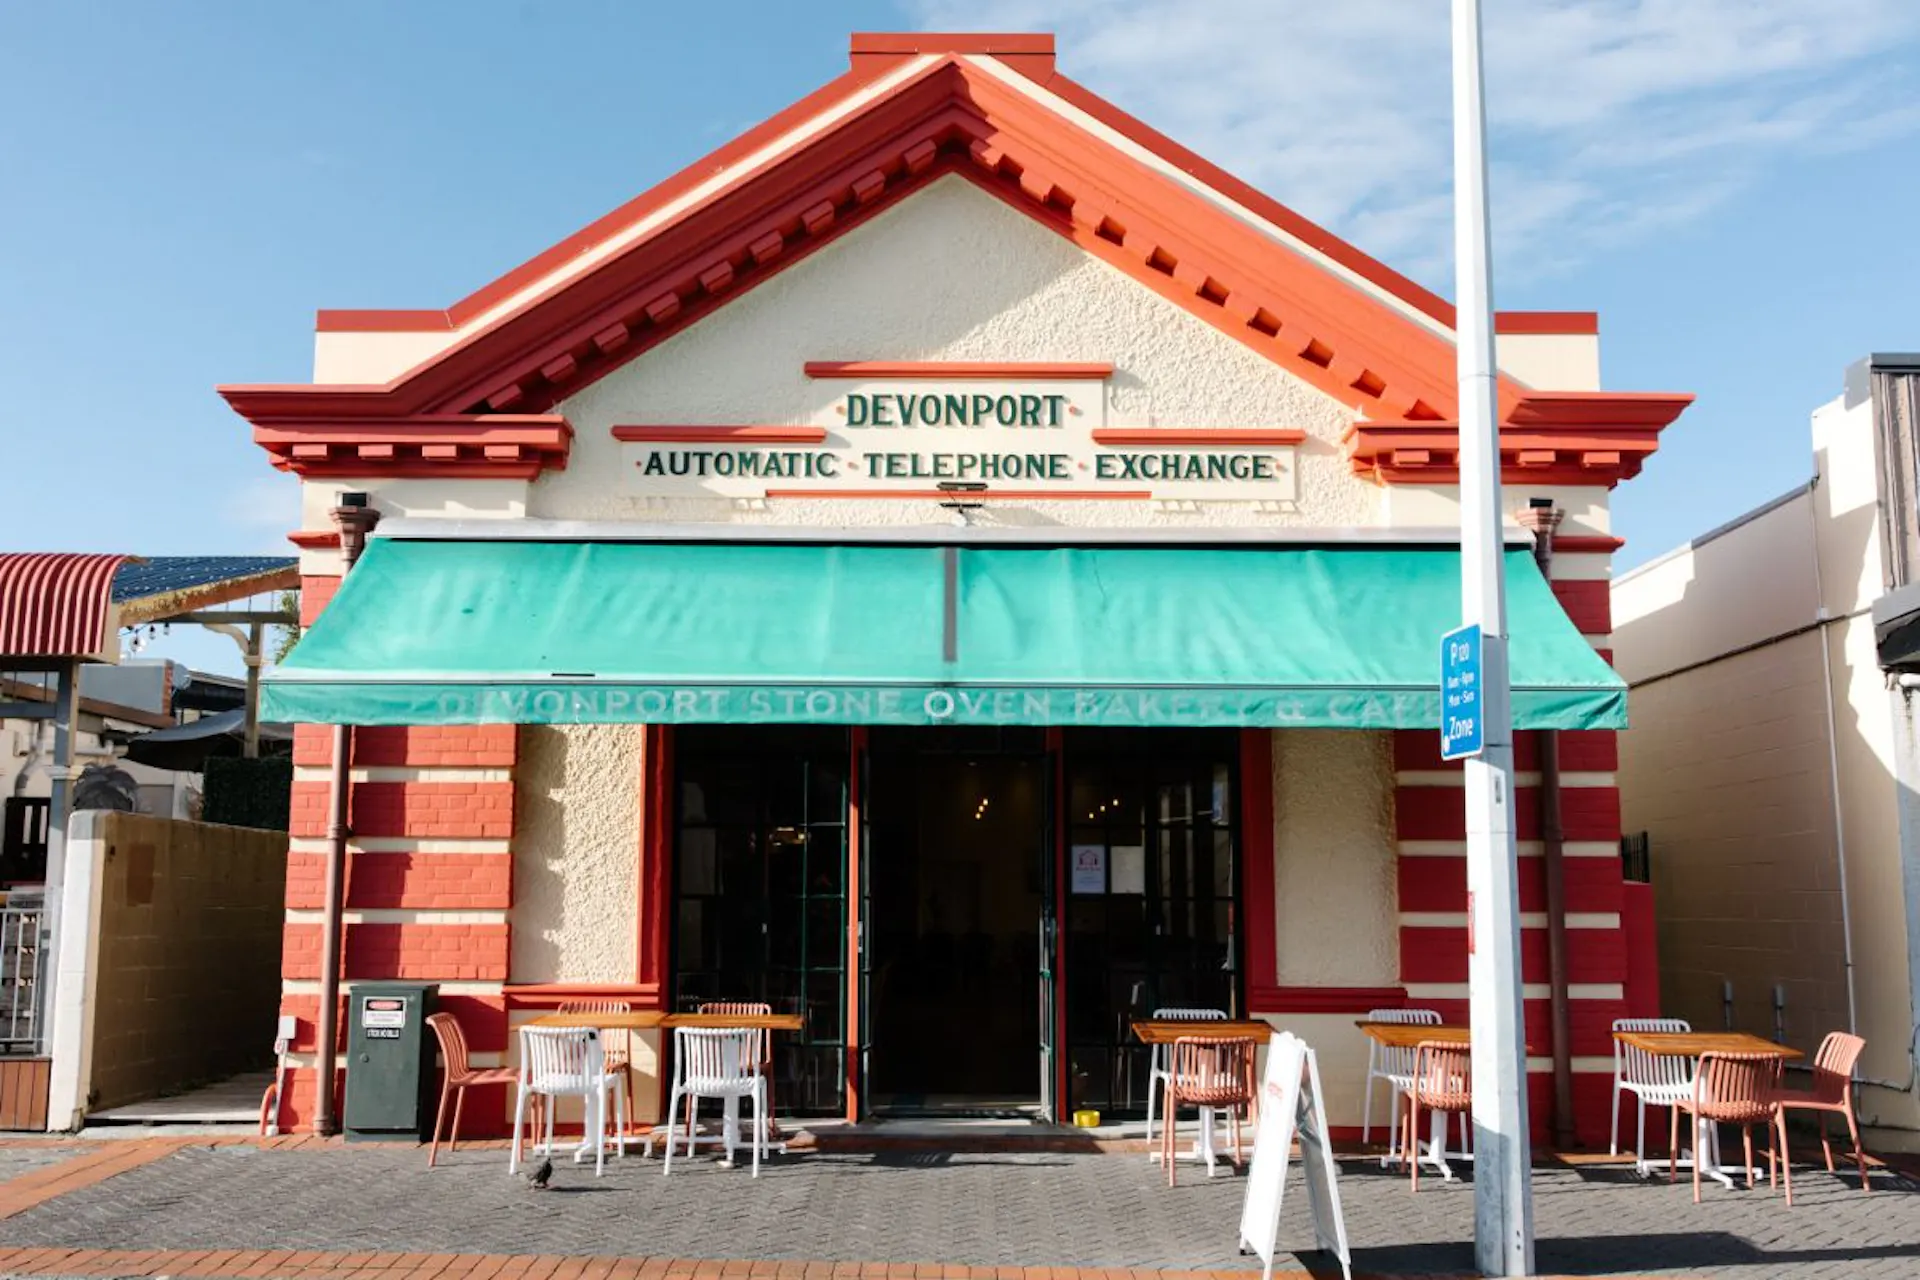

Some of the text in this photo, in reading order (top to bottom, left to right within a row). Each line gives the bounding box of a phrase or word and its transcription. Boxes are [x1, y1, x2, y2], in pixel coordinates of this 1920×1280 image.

[846, 394, 1065, 427] DEVONPORT
[643, 451, 1275, 480] AUTOMATIC TELEPHONE EXCHANGE
[751, 690, 900, 719] STONE
[924, 690, 1050, 719] OVEN
[1449, 716, 1473, 739] Zone
